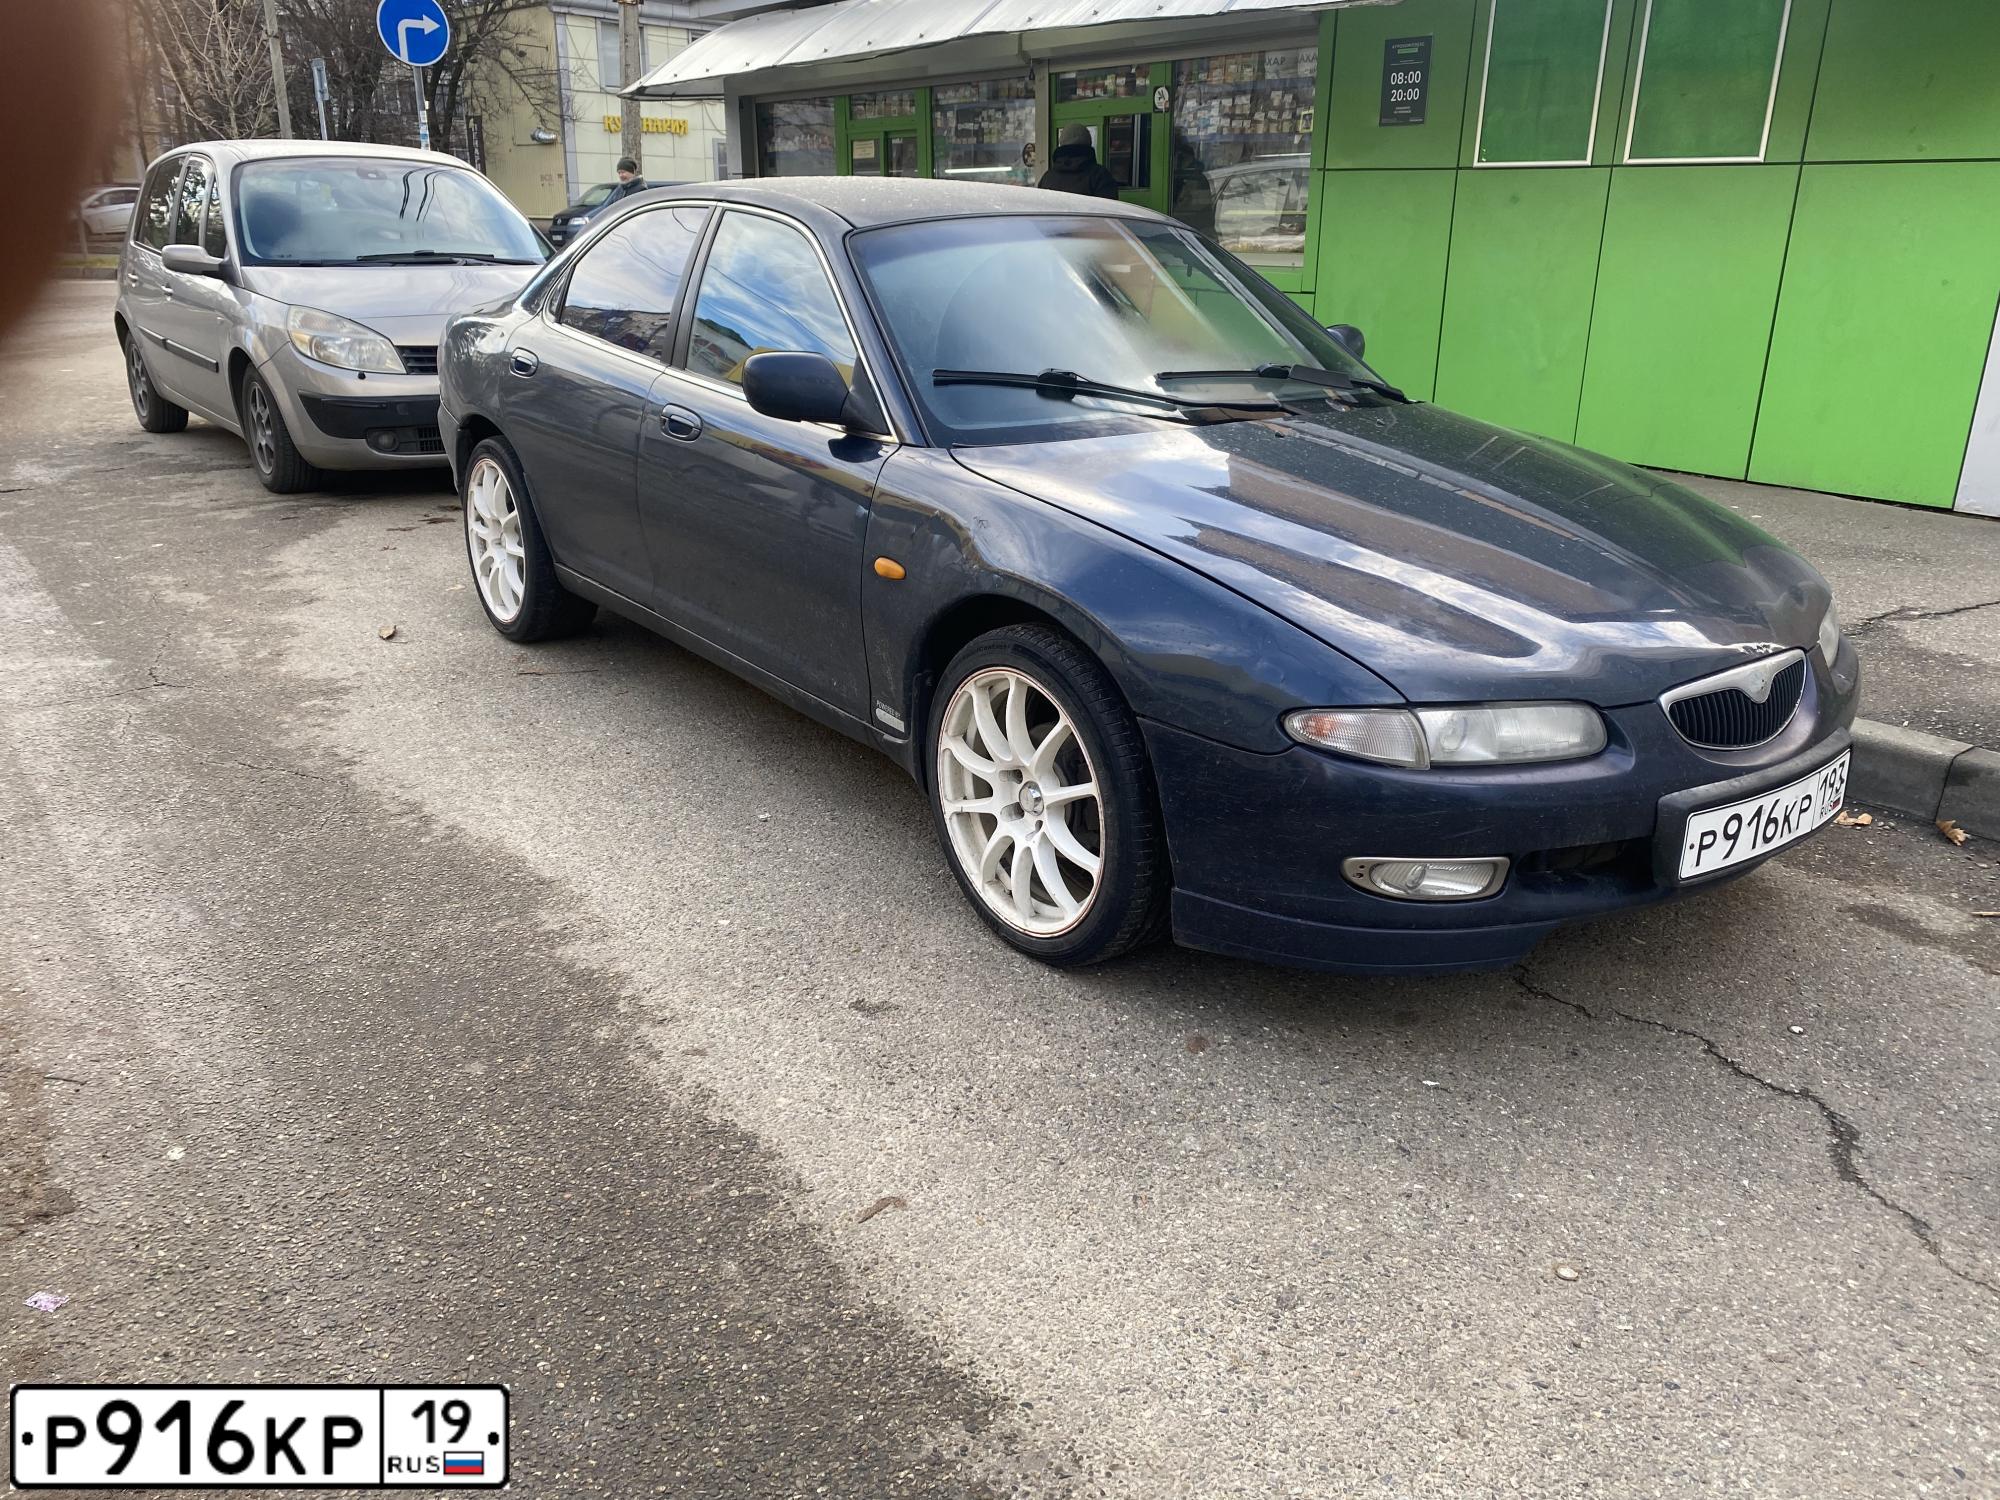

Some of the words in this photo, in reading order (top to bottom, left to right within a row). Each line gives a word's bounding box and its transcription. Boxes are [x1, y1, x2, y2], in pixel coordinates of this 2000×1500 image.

[1390, 70, 1422, 85] 08:00
[1390, 87, 1420, 102] 20:00
[603, 115, 689, 137] КУНАРИЯ
[1695, 794, 1812, 867] Р916КР
[1819, 760, 1846, 804] 193
